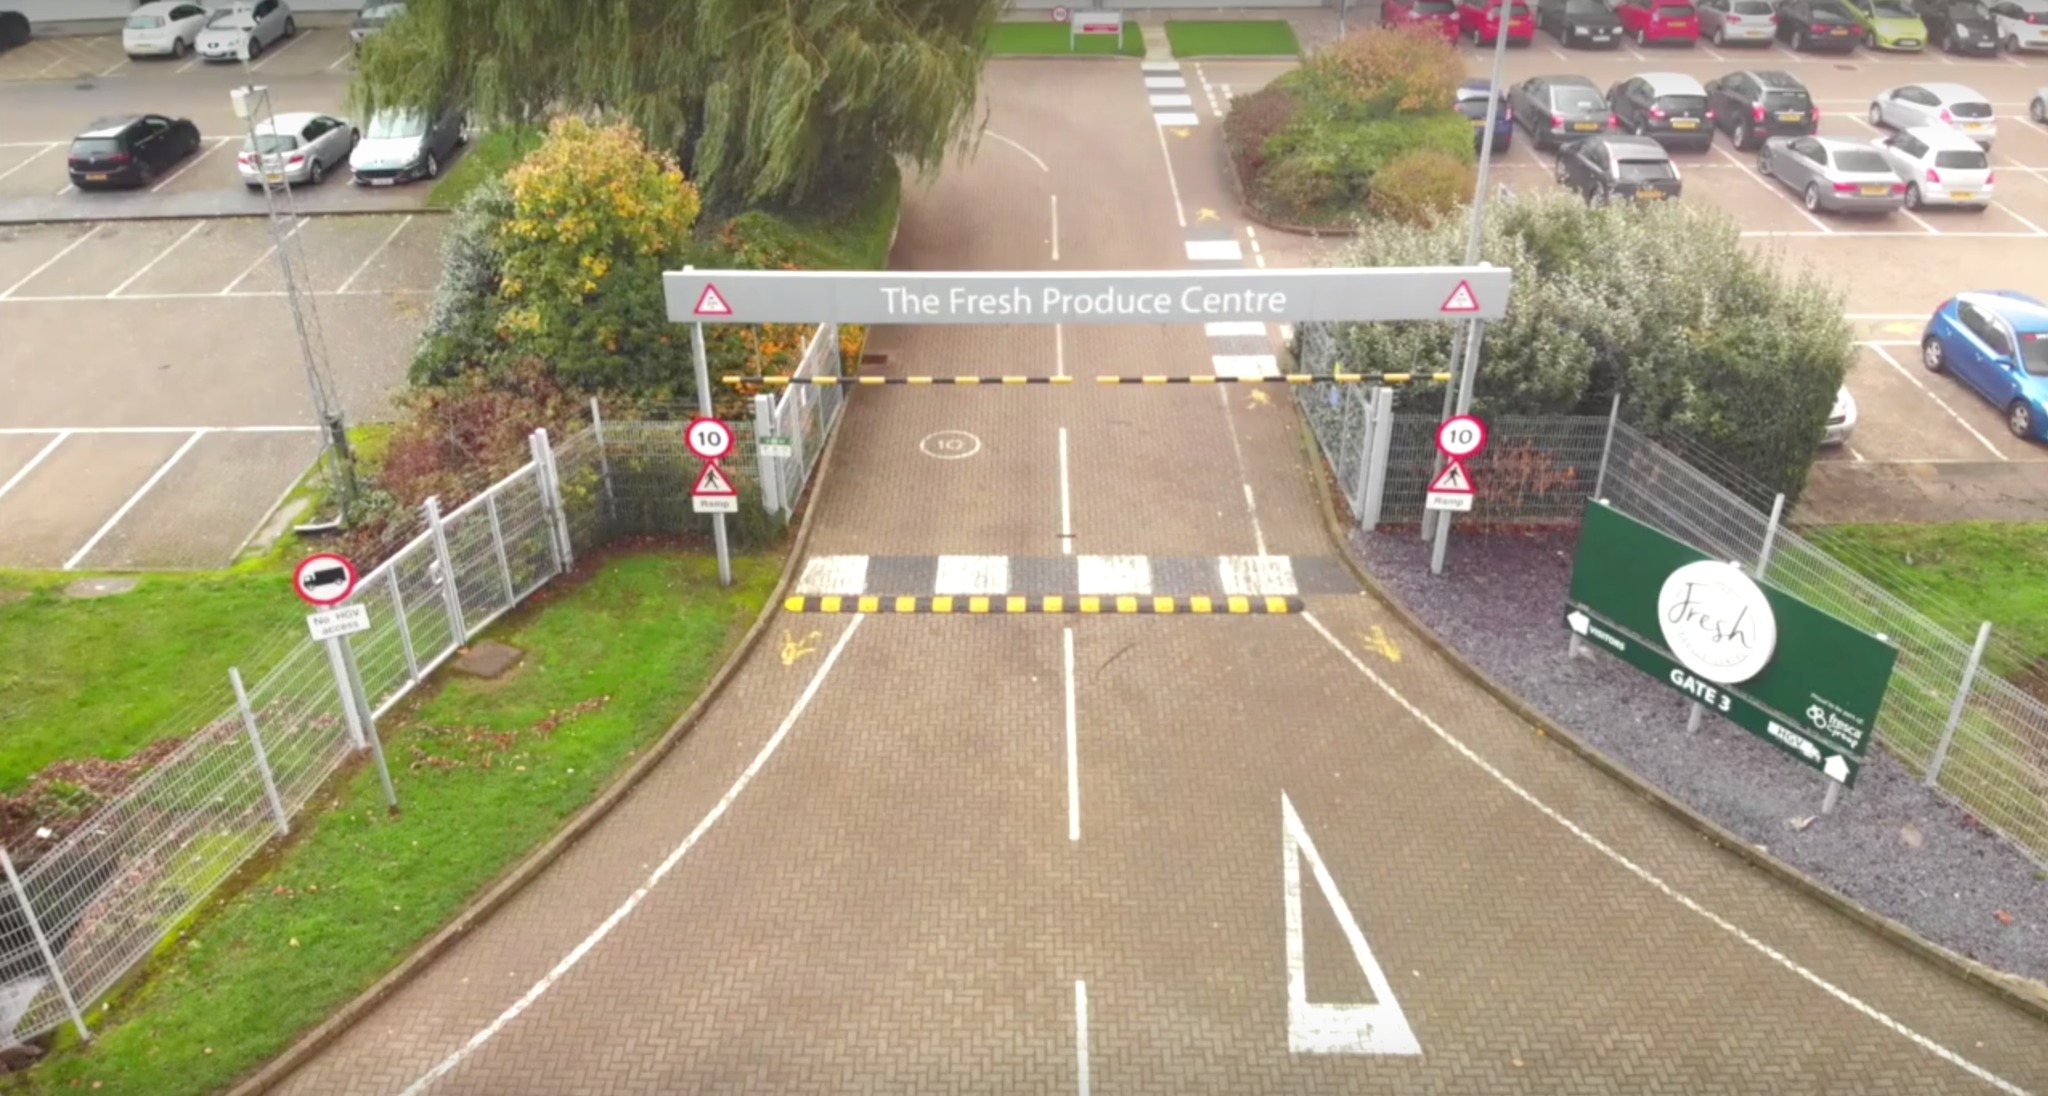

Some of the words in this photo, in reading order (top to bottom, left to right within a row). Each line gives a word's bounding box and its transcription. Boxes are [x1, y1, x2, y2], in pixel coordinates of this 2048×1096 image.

[880, 287, 940, 314] The
[950, 287, 1032, 314] Fresh
[1043, 286, 1171, 314] Produce
[1181, 286, 1287, 313] Centre
[698, 431, 721, 447] 10
[938, 439, 963, 450] 10
[1450, 429, 1473, 444] 10
[700, 500, 729, 509] Ramp
[1434, 496, 1464, 507] Ramp
[314, 616, 330, 626] No
[335, 608, 359, 620] HGV
[1668, 582, 1753, 649] Fresh
[322, 621, 359, 634] access
[1590, 625, 1626, 651] VISITORS
[1670, 668, 1717, 704] GATE
[1718, 694, 1732, 712] 3
[1777, 726, 1804, 747] HGV
